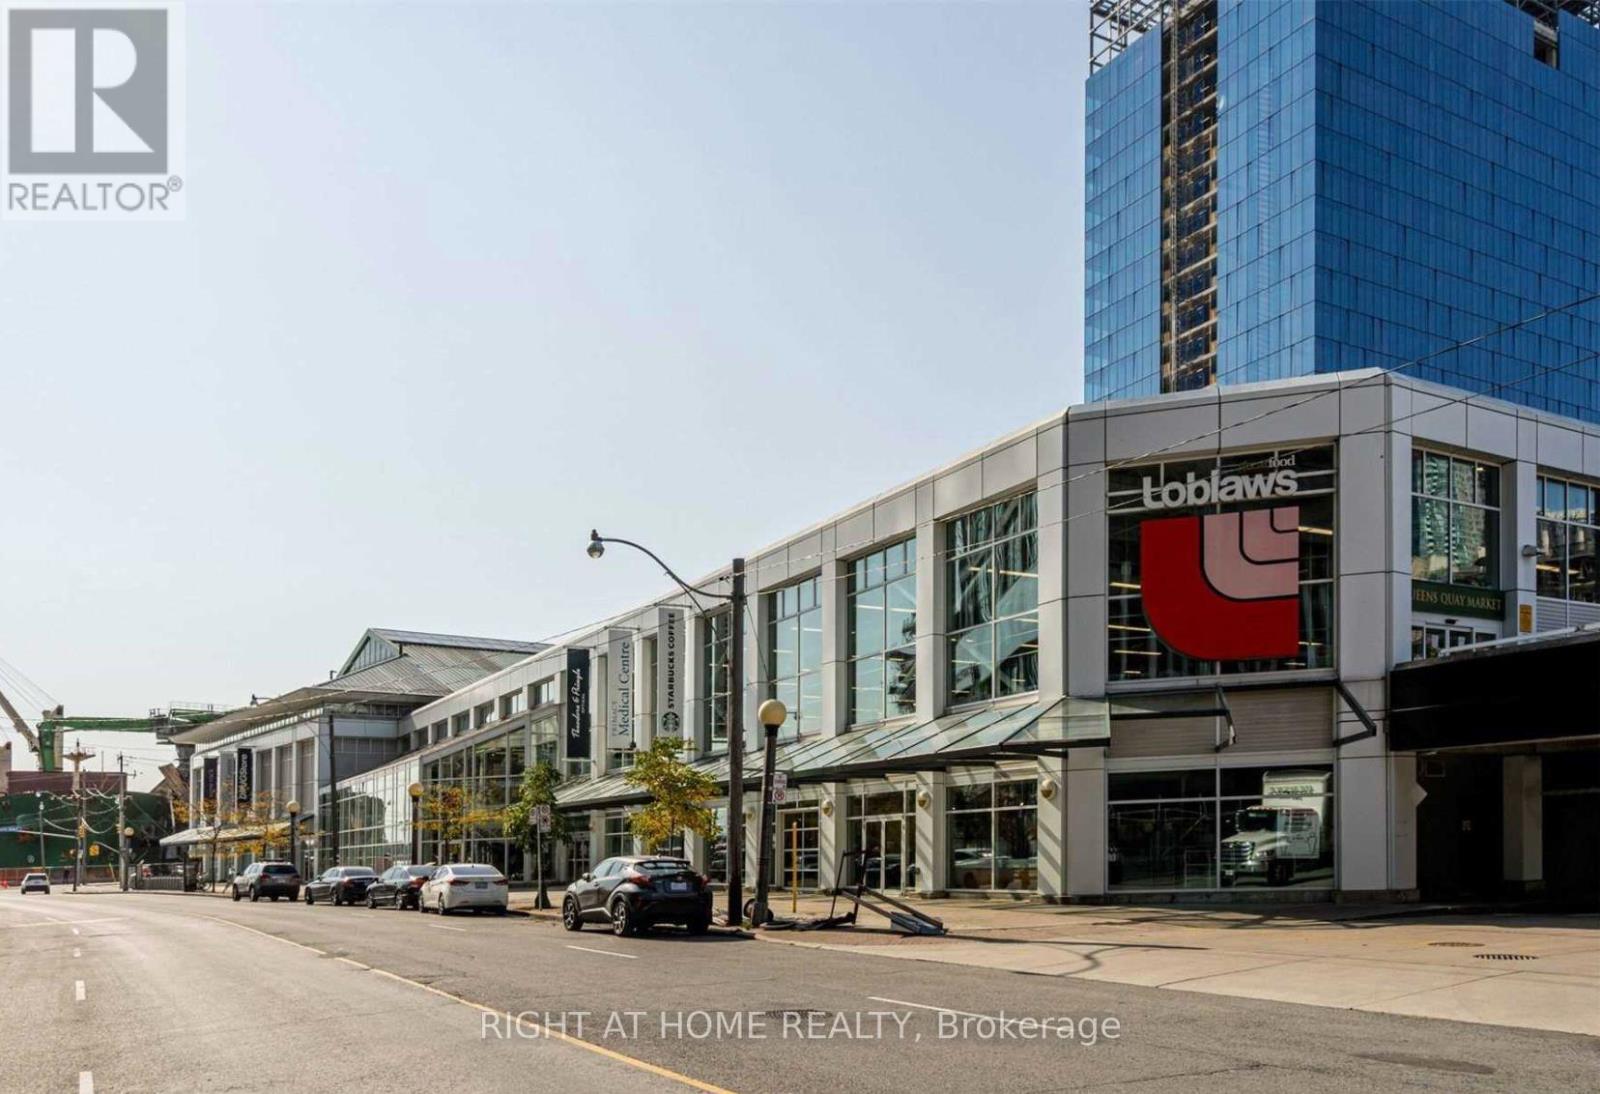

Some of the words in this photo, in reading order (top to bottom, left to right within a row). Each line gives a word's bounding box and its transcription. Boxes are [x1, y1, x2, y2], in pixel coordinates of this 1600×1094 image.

[1269, 455, 1296, 468] food
[1416, 589, 1437, 604] EENS
[1441, 592, 1466, 606] QUAY
[1468, 597, 1501, 611] MARKET
[619, 641, 630, 684] Centre
[667, 651, 675, 709] STARBUCKS
[618, 687, 630, 736] Medical
